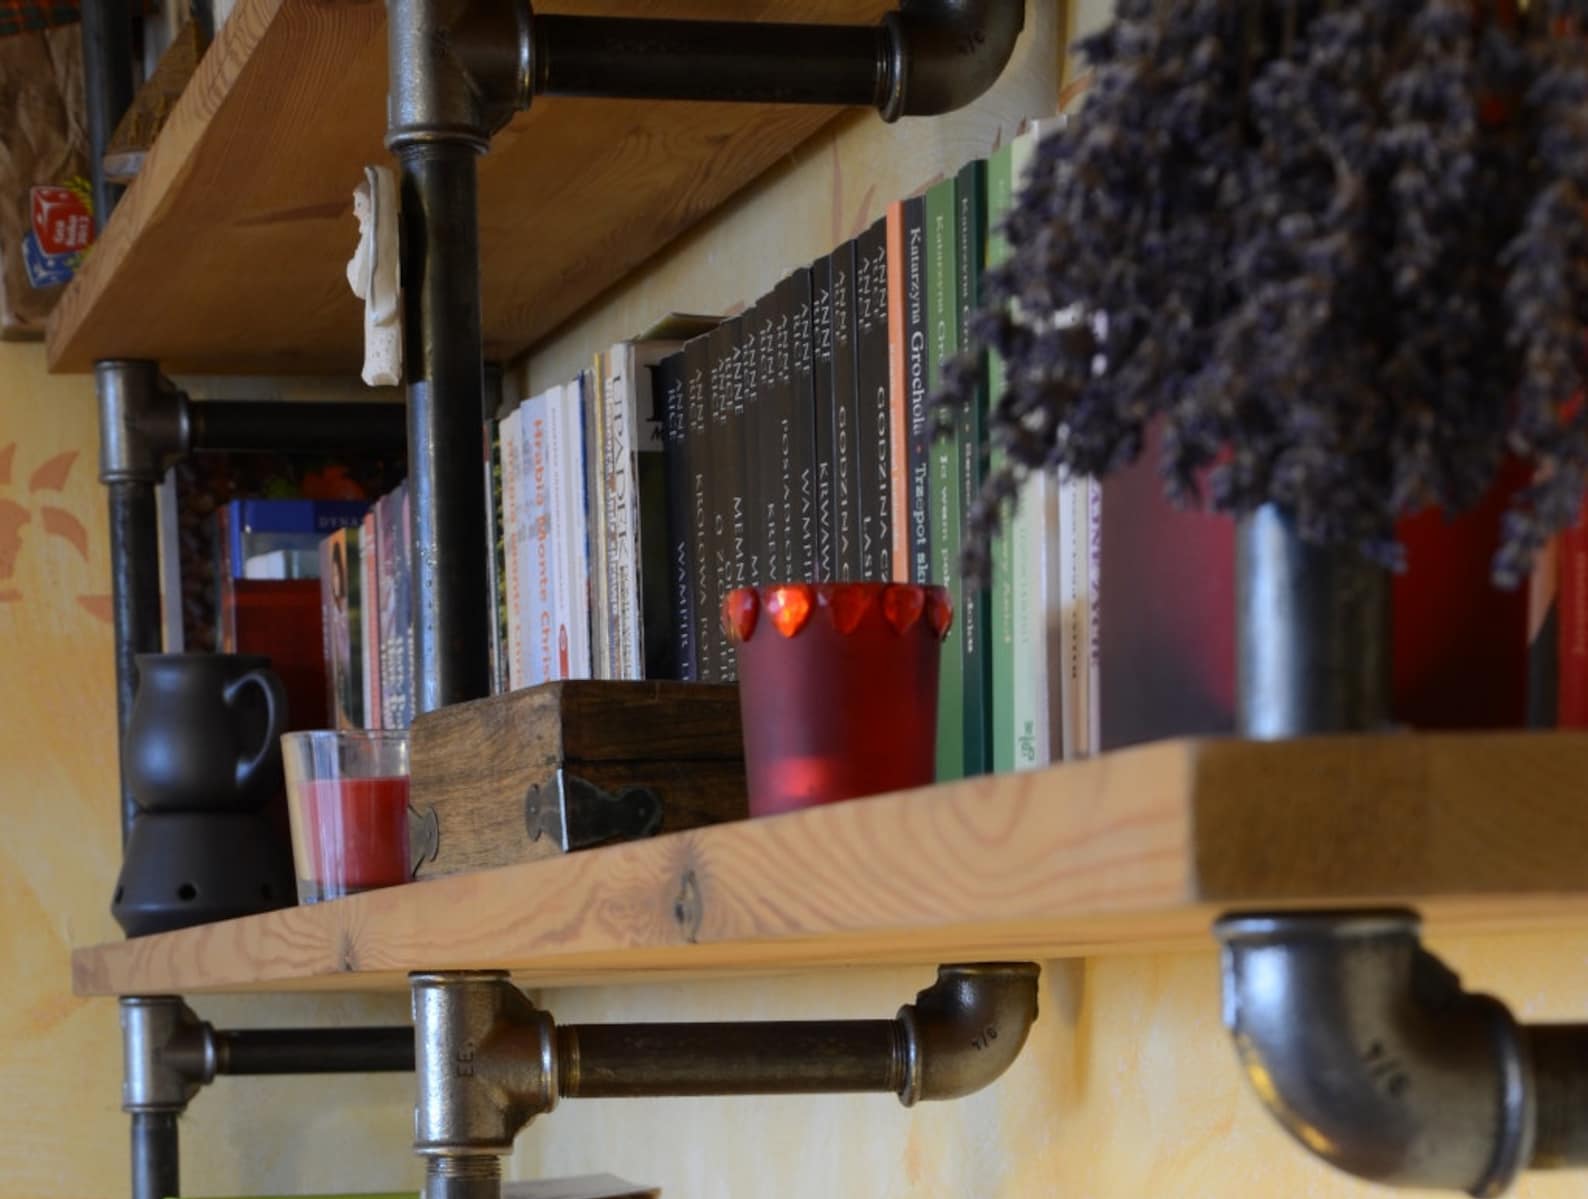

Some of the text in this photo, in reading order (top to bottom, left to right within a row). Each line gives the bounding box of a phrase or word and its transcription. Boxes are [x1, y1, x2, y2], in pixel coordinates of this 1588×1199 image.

[909, 226, 923, 325] Katarzyna
[838, 405, 850, 553] GODZINA
[877, 386, 887, 540] GODZINA
[536, 515, 548, 603] Monte
